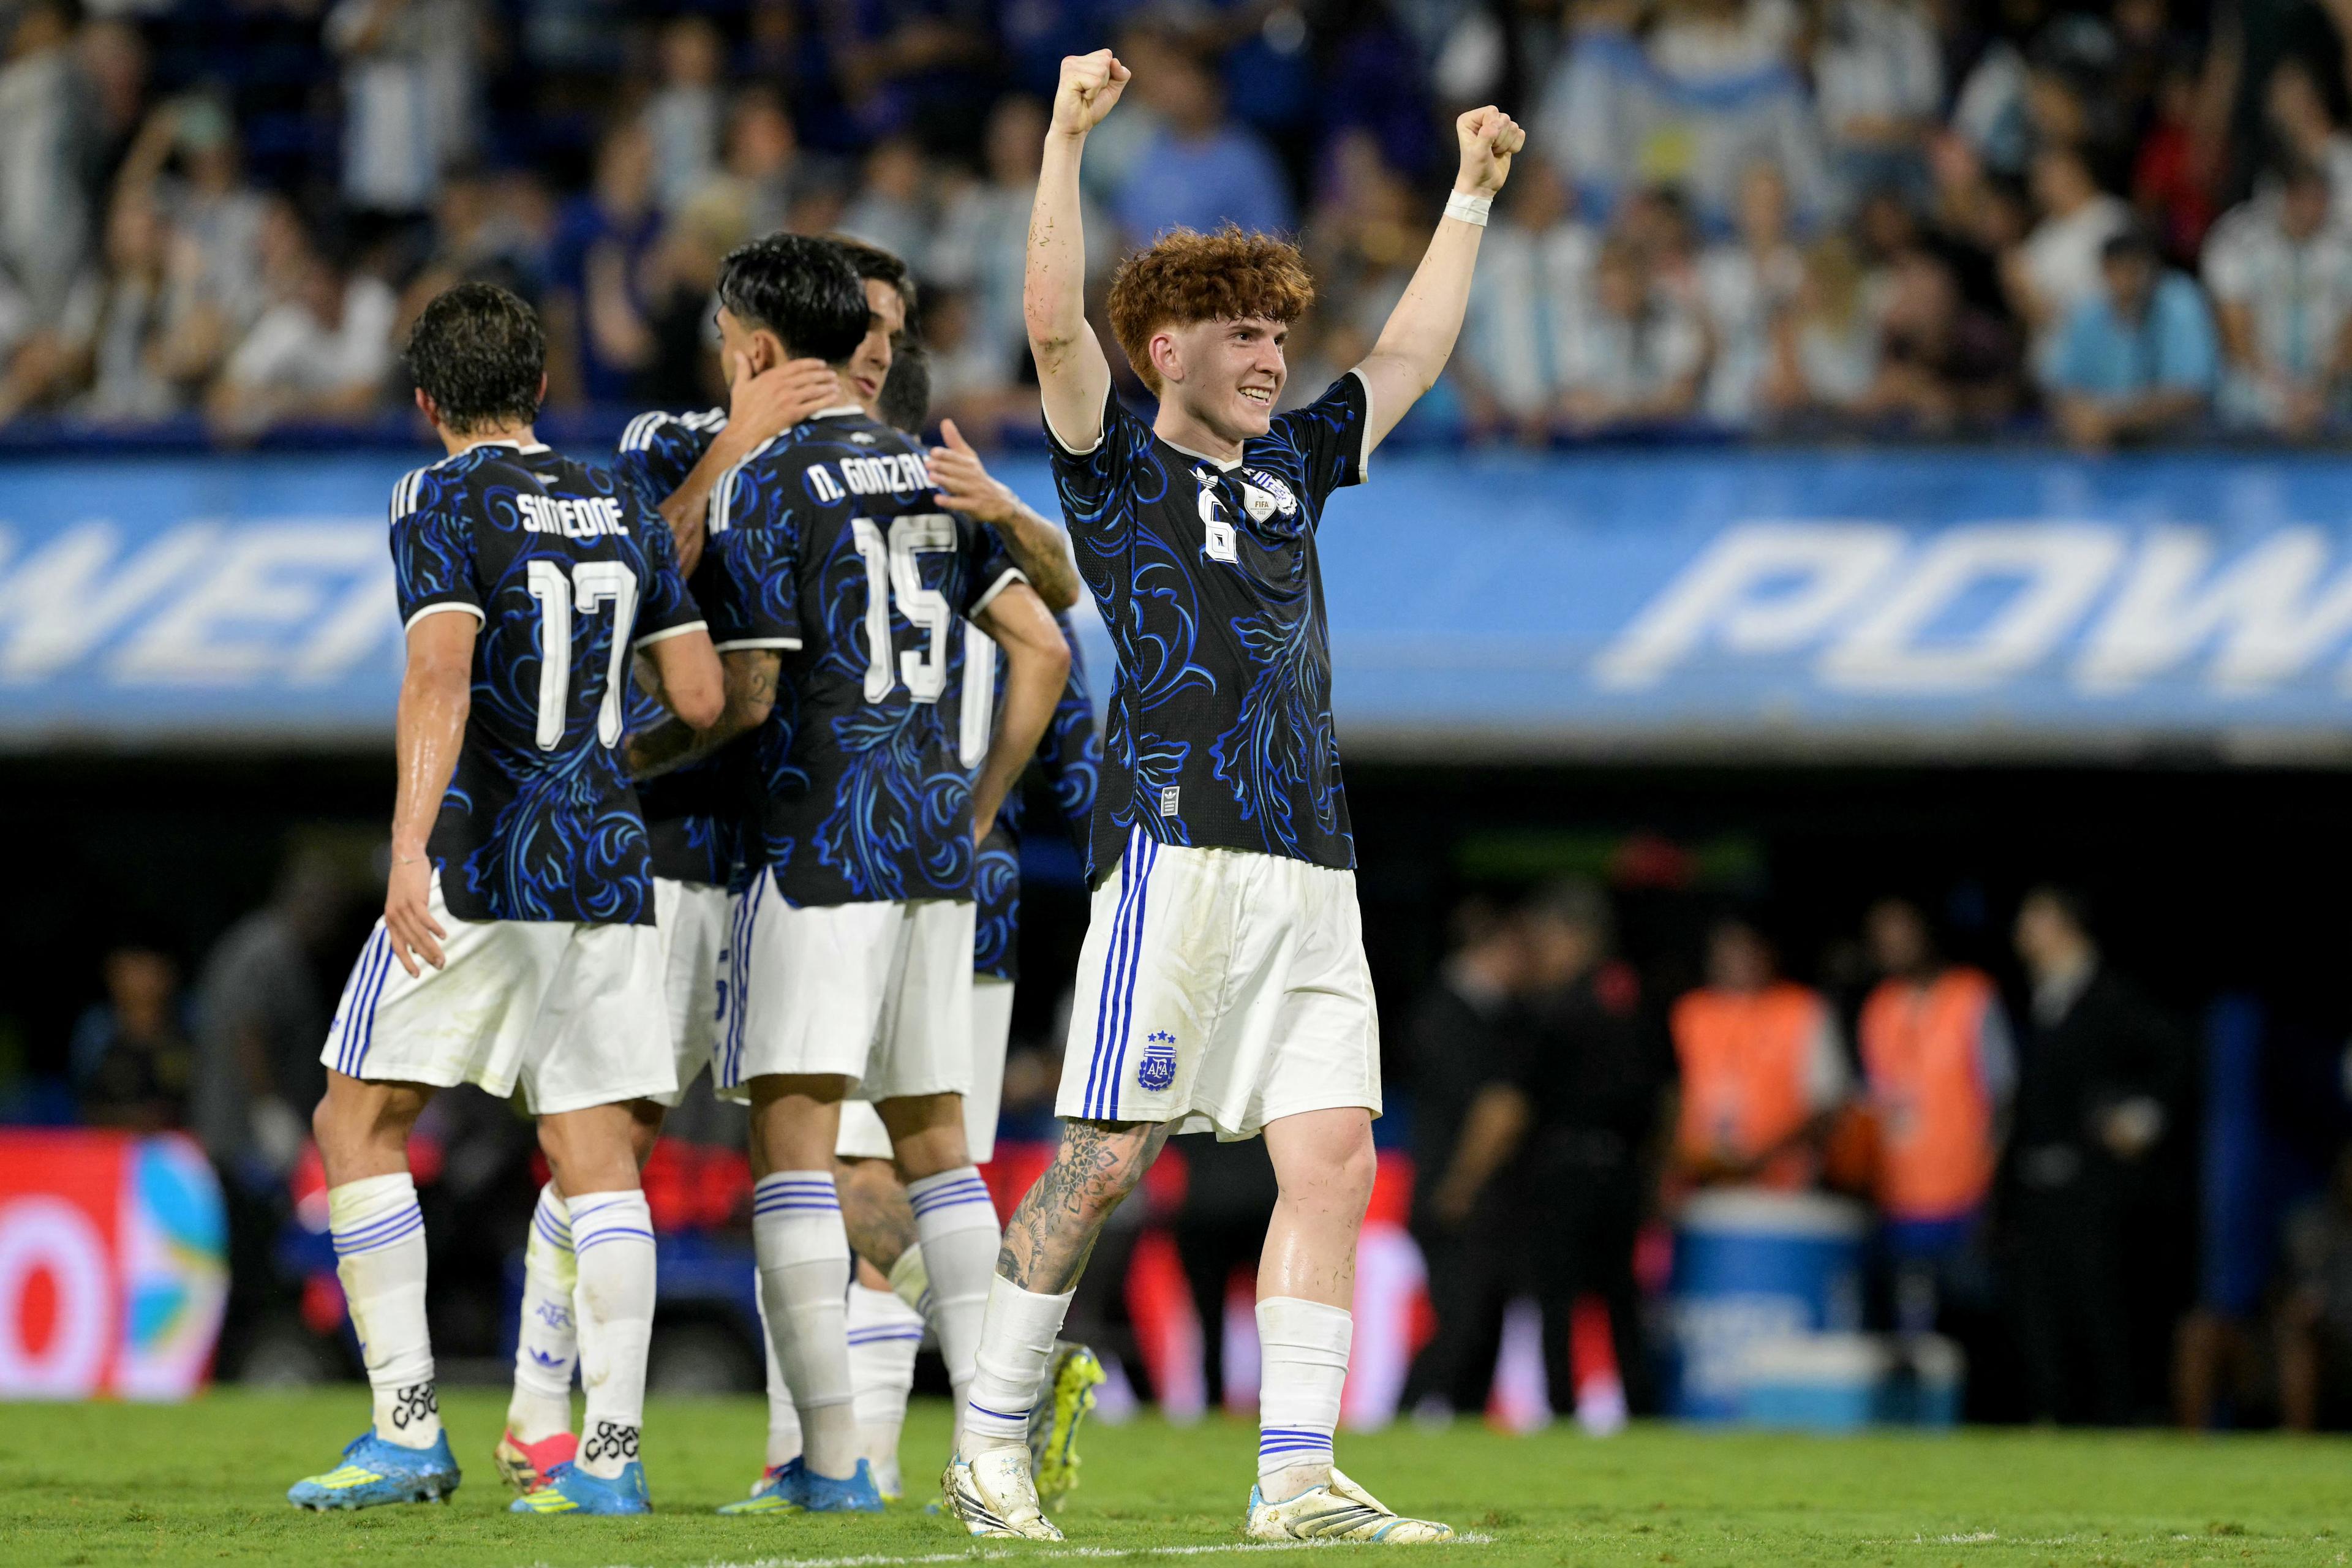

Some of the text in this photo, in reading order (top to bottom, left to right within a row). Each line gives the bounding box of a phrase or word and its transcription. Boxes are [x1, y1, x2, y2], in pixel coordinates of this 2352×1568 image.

[807, 453, 940, 502] N. GONZAL
[516, 493, 630, 538] SIMEONE
[1198, 488, 1238, 564] 6
[851, 513, 957, 704] 15
[527, 560, 639, 752] 17
[1147, 1057, 1168, 1079] AFA
